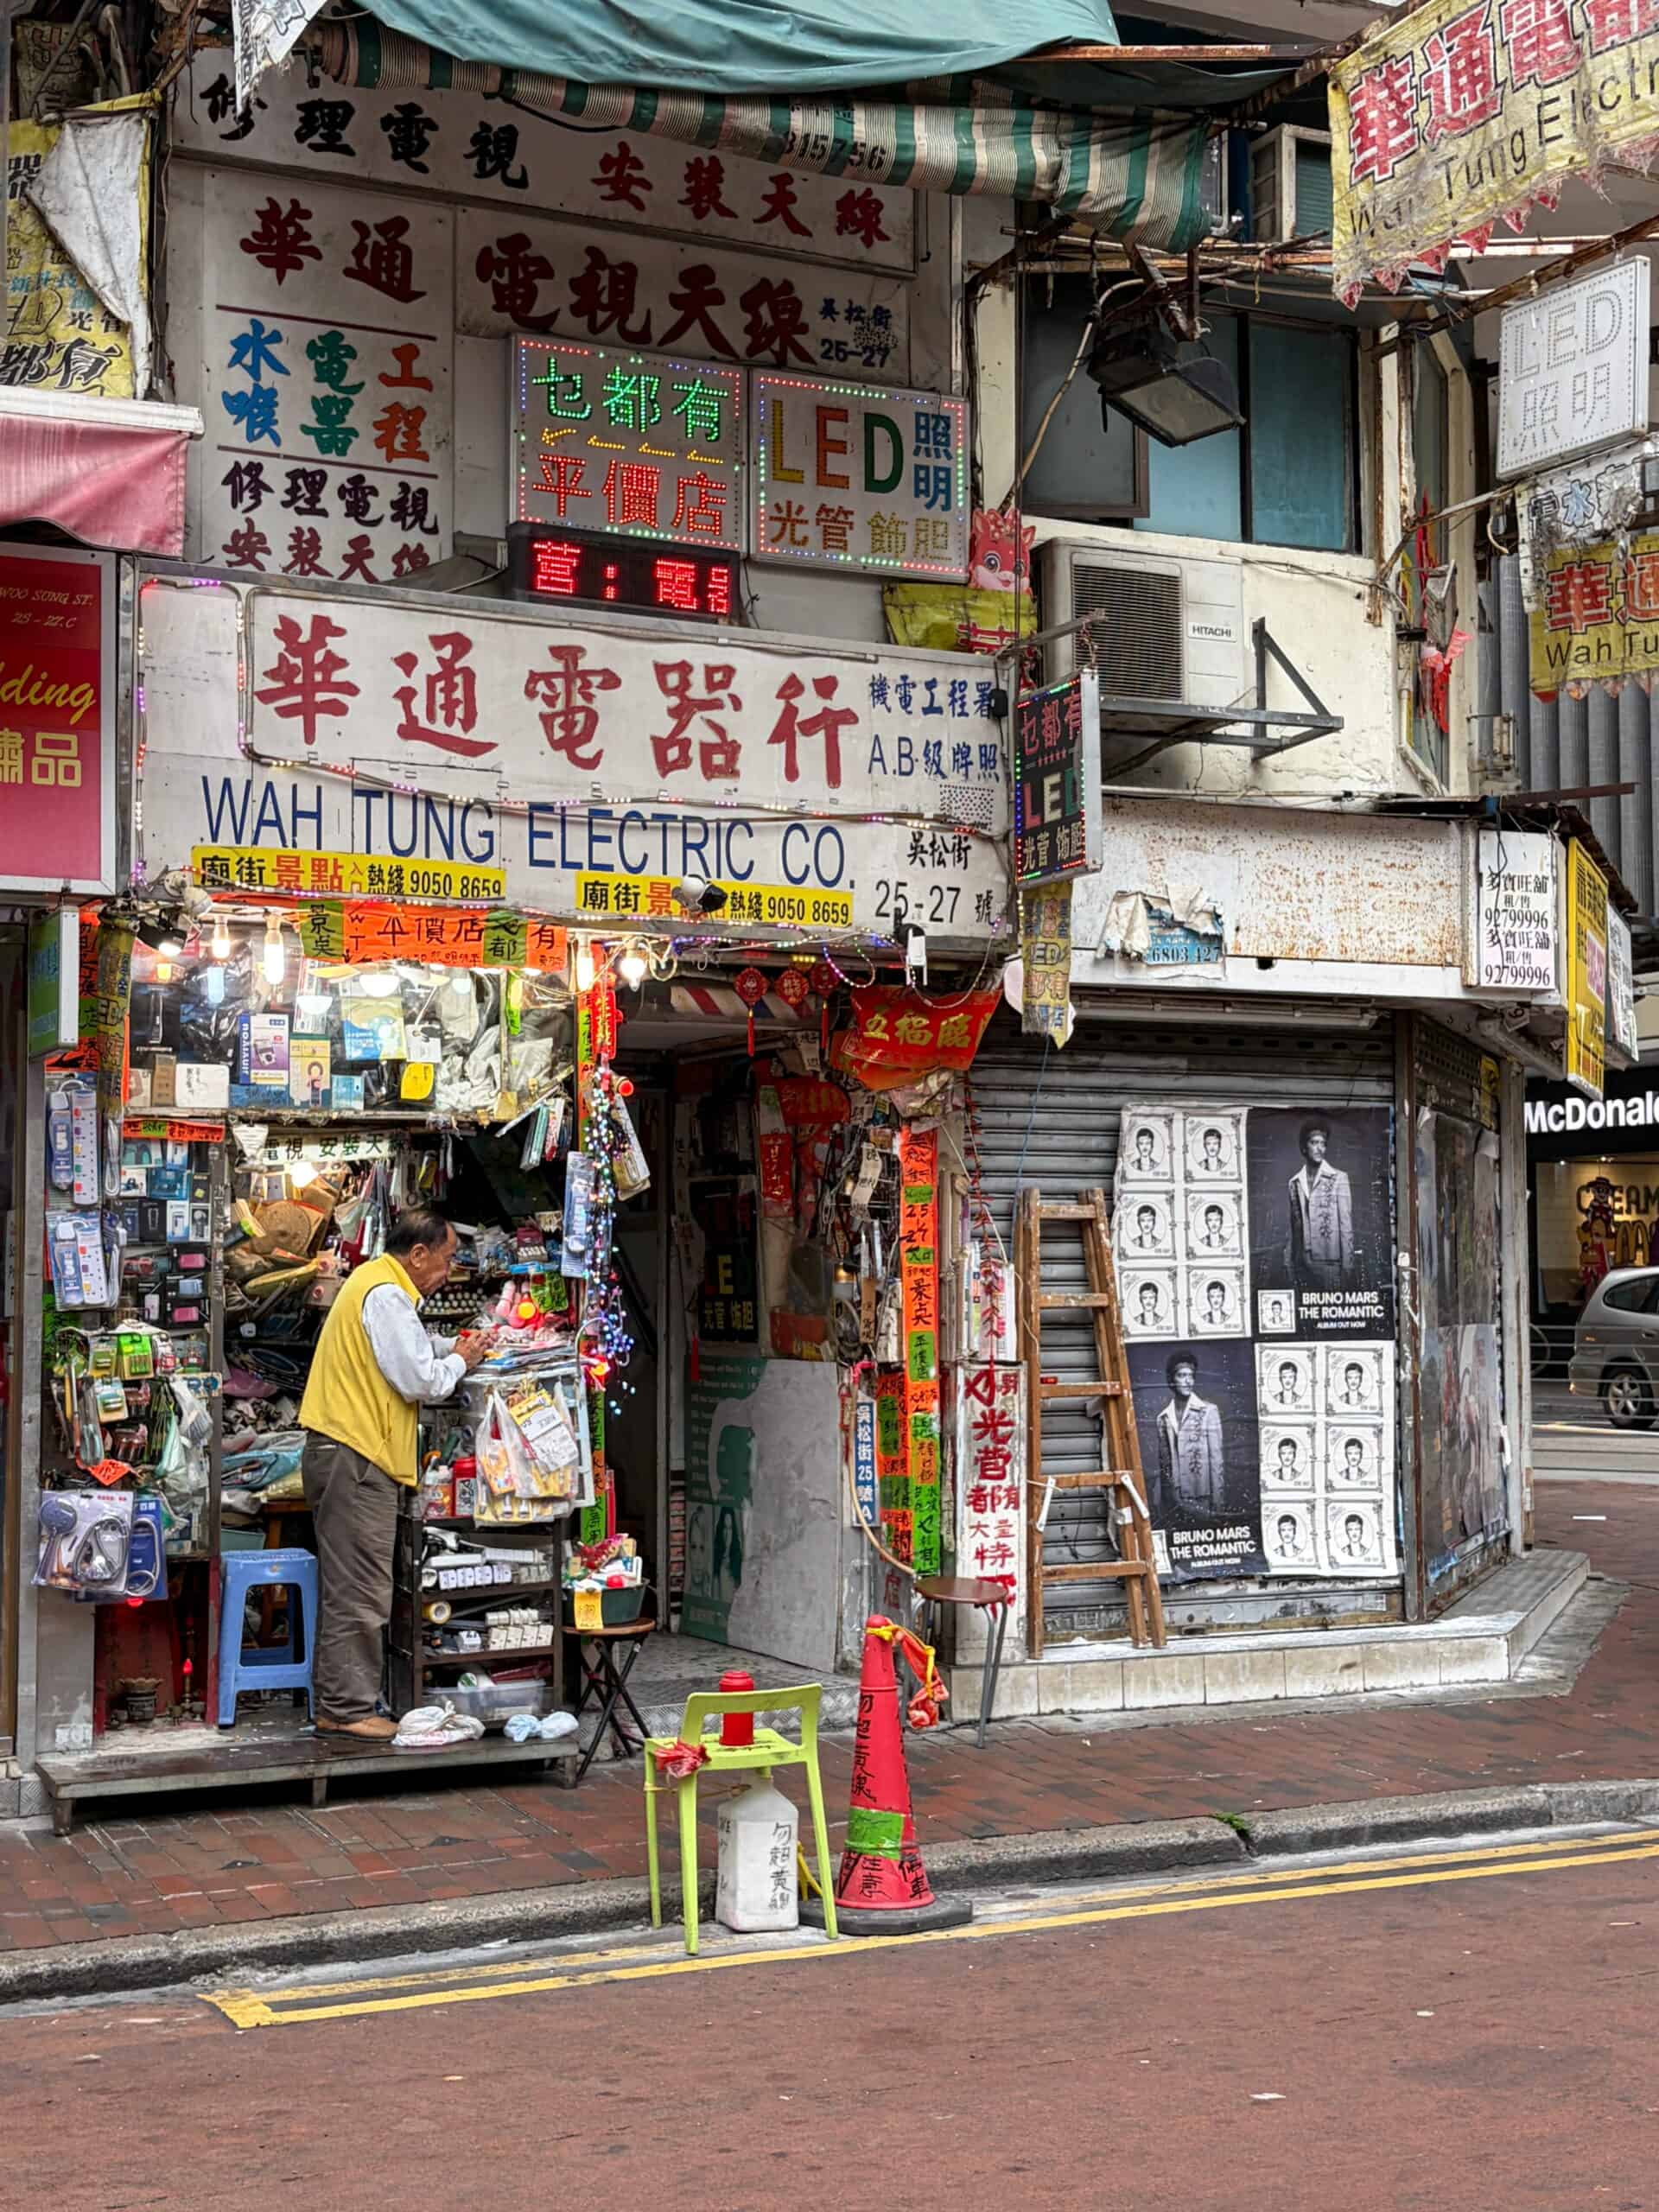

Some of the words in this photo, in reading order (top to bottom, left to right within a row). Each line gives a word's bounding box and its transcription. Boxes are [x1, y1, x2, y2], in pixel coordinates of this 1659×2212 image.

[240, 197, 427, 302] 華通
[475, 232, 818, 366] 電視天線
[1512, 290, 1623, 382] LED
[772, 398, 904, 493] LED
[221, 461, 439, 535] 修理電視
[532, 454, 728, 537] 平價店
[1192, 625, 1231, 638] HITACHI
[1546, 637, 1612, 670] Wah
[254, 614, 860, 789] 華通電器行
[201, 775, 322, 851] WAH
[353, 788, 494, 864] TUNG
[527, 802, 754, 880] ELECTRIC
[781, 822, 855, 890] CO.
[410, 870, 452, 896] 9050
[767, 895, 806, 921] 9050
[812, 899, 849, 925] 8659
[1484, 907, 1549, 931] 92799996
[1484, 963, 1551, 987] 92799996
[1299, 1306, 1319, 1319] THE
[1322, 1305, 1385, 1319] ROMANTIC
[1302, 1292, 1344, 1305] BRUNO
[1345, 1291, 1379, 1304] MARS
[1169, 1546, 1192, 1559] THE
[1193, 1541, 1256, 1557] ROMANTIC
[1173, 1529, 1215, 1545] BRUNO
[1216, 1526, 1251, 1540] MARS
